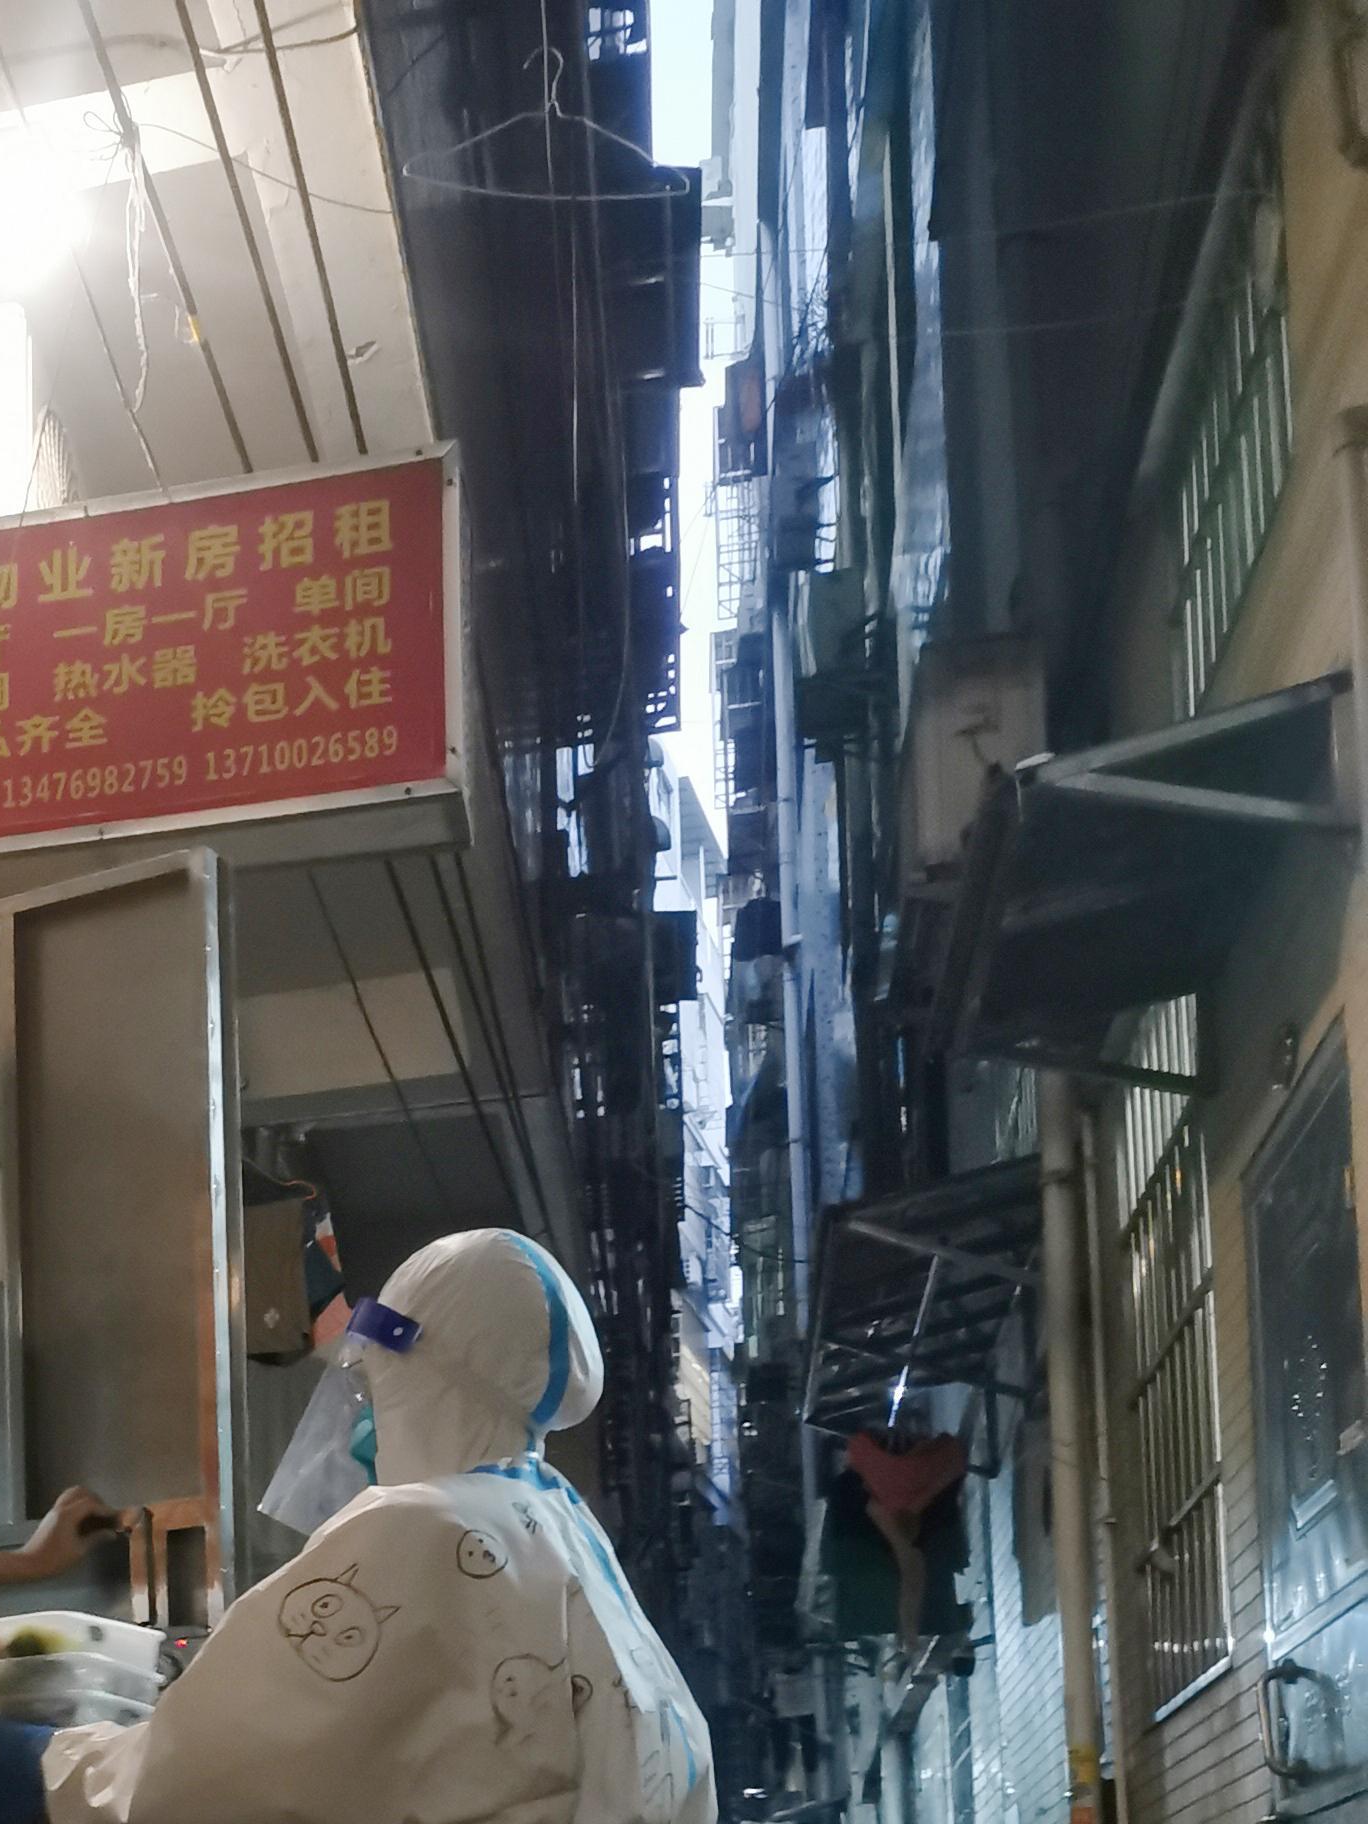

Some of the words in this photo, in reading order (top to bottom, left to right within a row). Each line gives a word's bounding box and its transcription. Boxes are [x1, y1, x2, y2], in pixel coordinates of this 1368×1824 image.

[53, 588, 248, 646] 一房一厅
[293, 566, 391, 616] 单间
[53, 645, 197, 702] 热水器
[242, 616, 392, 675] 洗衣机
[191, 666, 392, 732] 拎包入住
[205, 725, 398, 781] 13710026589
